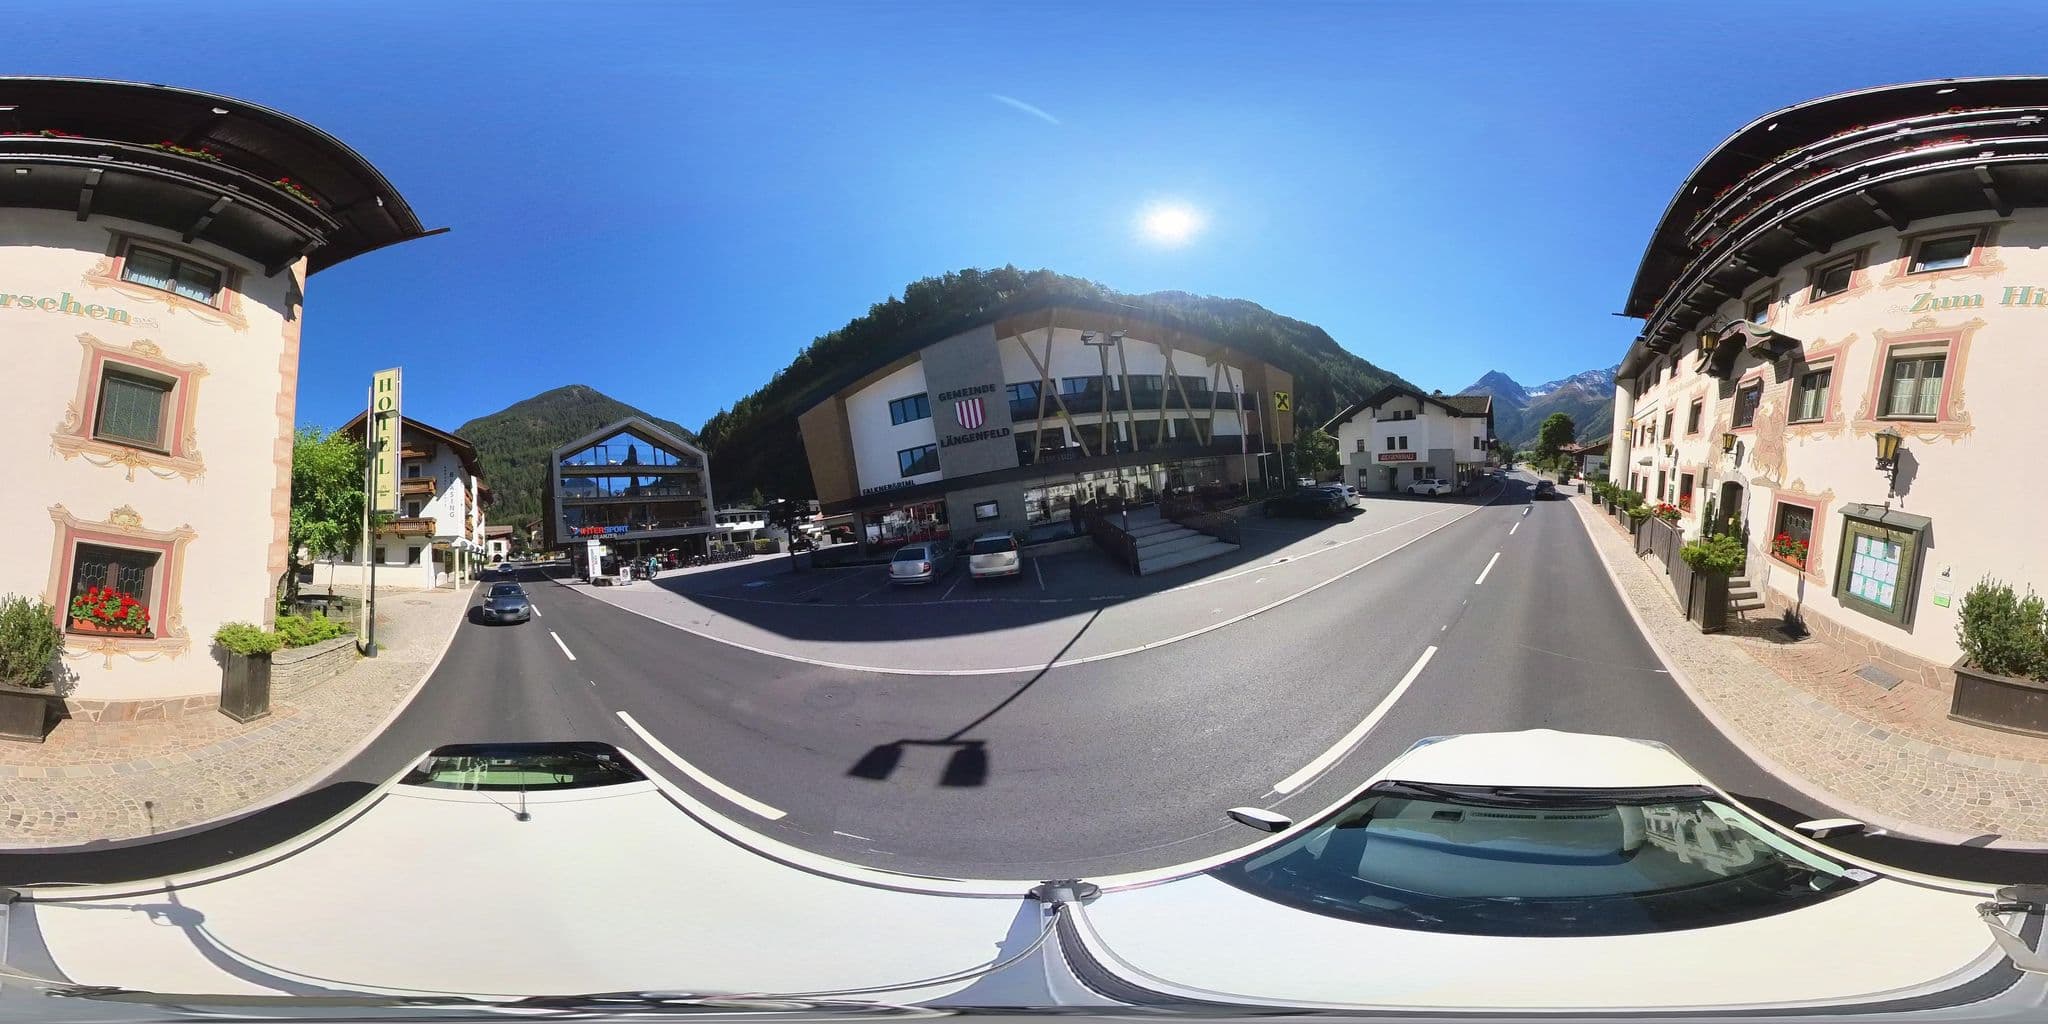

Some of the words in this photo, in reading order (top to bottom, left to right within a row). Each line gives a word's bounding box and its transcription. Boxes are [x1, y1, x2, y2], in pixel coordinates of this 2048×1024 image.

[1909, 292, 1985, 314] Zum
[938, 384, 996, 401] GEMEINDE
[378, 378, 392, 475] HOTEL
[940, 428, 1010, 448] LÄNGENFELD
[580, 526, 629, 535] INTERSPORT
